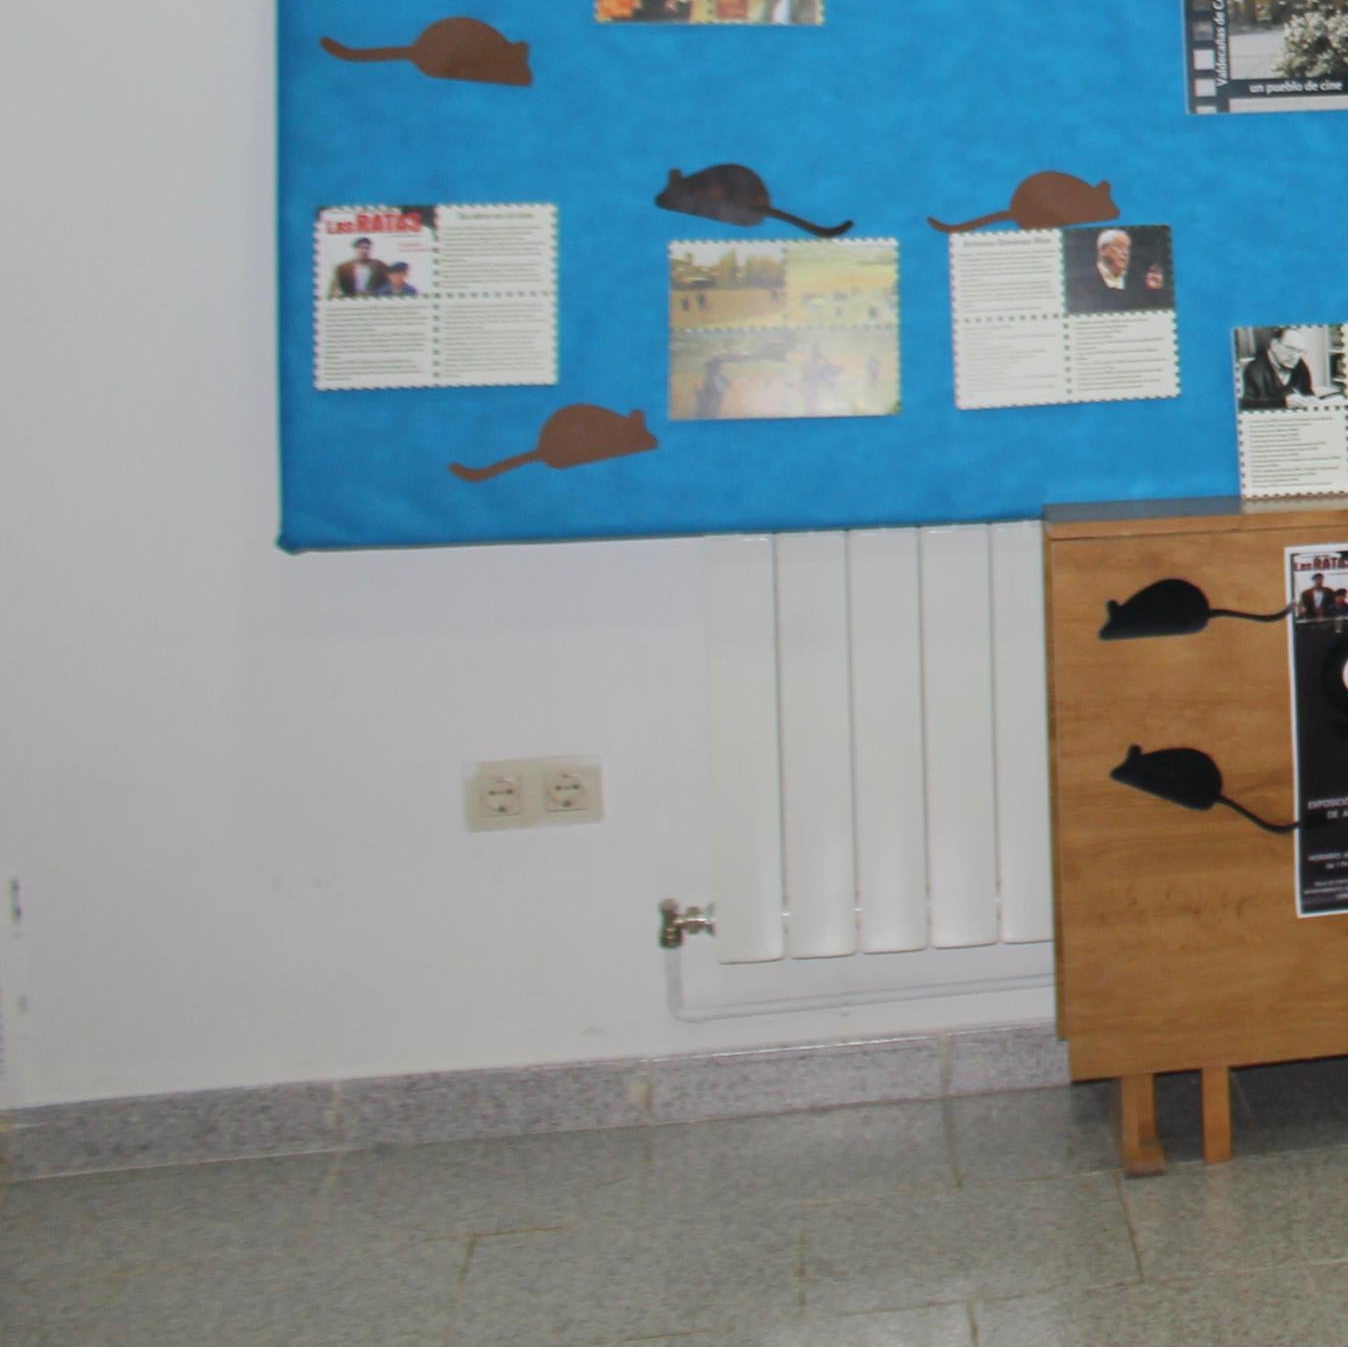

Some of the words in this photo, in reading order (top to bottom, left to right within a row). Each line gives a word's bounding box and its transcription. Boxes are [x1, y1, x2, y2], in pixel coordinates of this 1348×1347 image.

[1213, 11, 1226, 26] de
[1214, 28, 1228, 87] Valdecañas
[1249, 83, 1265, 94] un
[1266, 80, 1303, 95] pueblo
[1304, 80, 1319, 92] de
[1320, 79, 1343, 91] cine
[326, 218, 353, 234] Las
[356, 212, 423, 233] RATAS
[1327, 810, 1338, 819] DE
